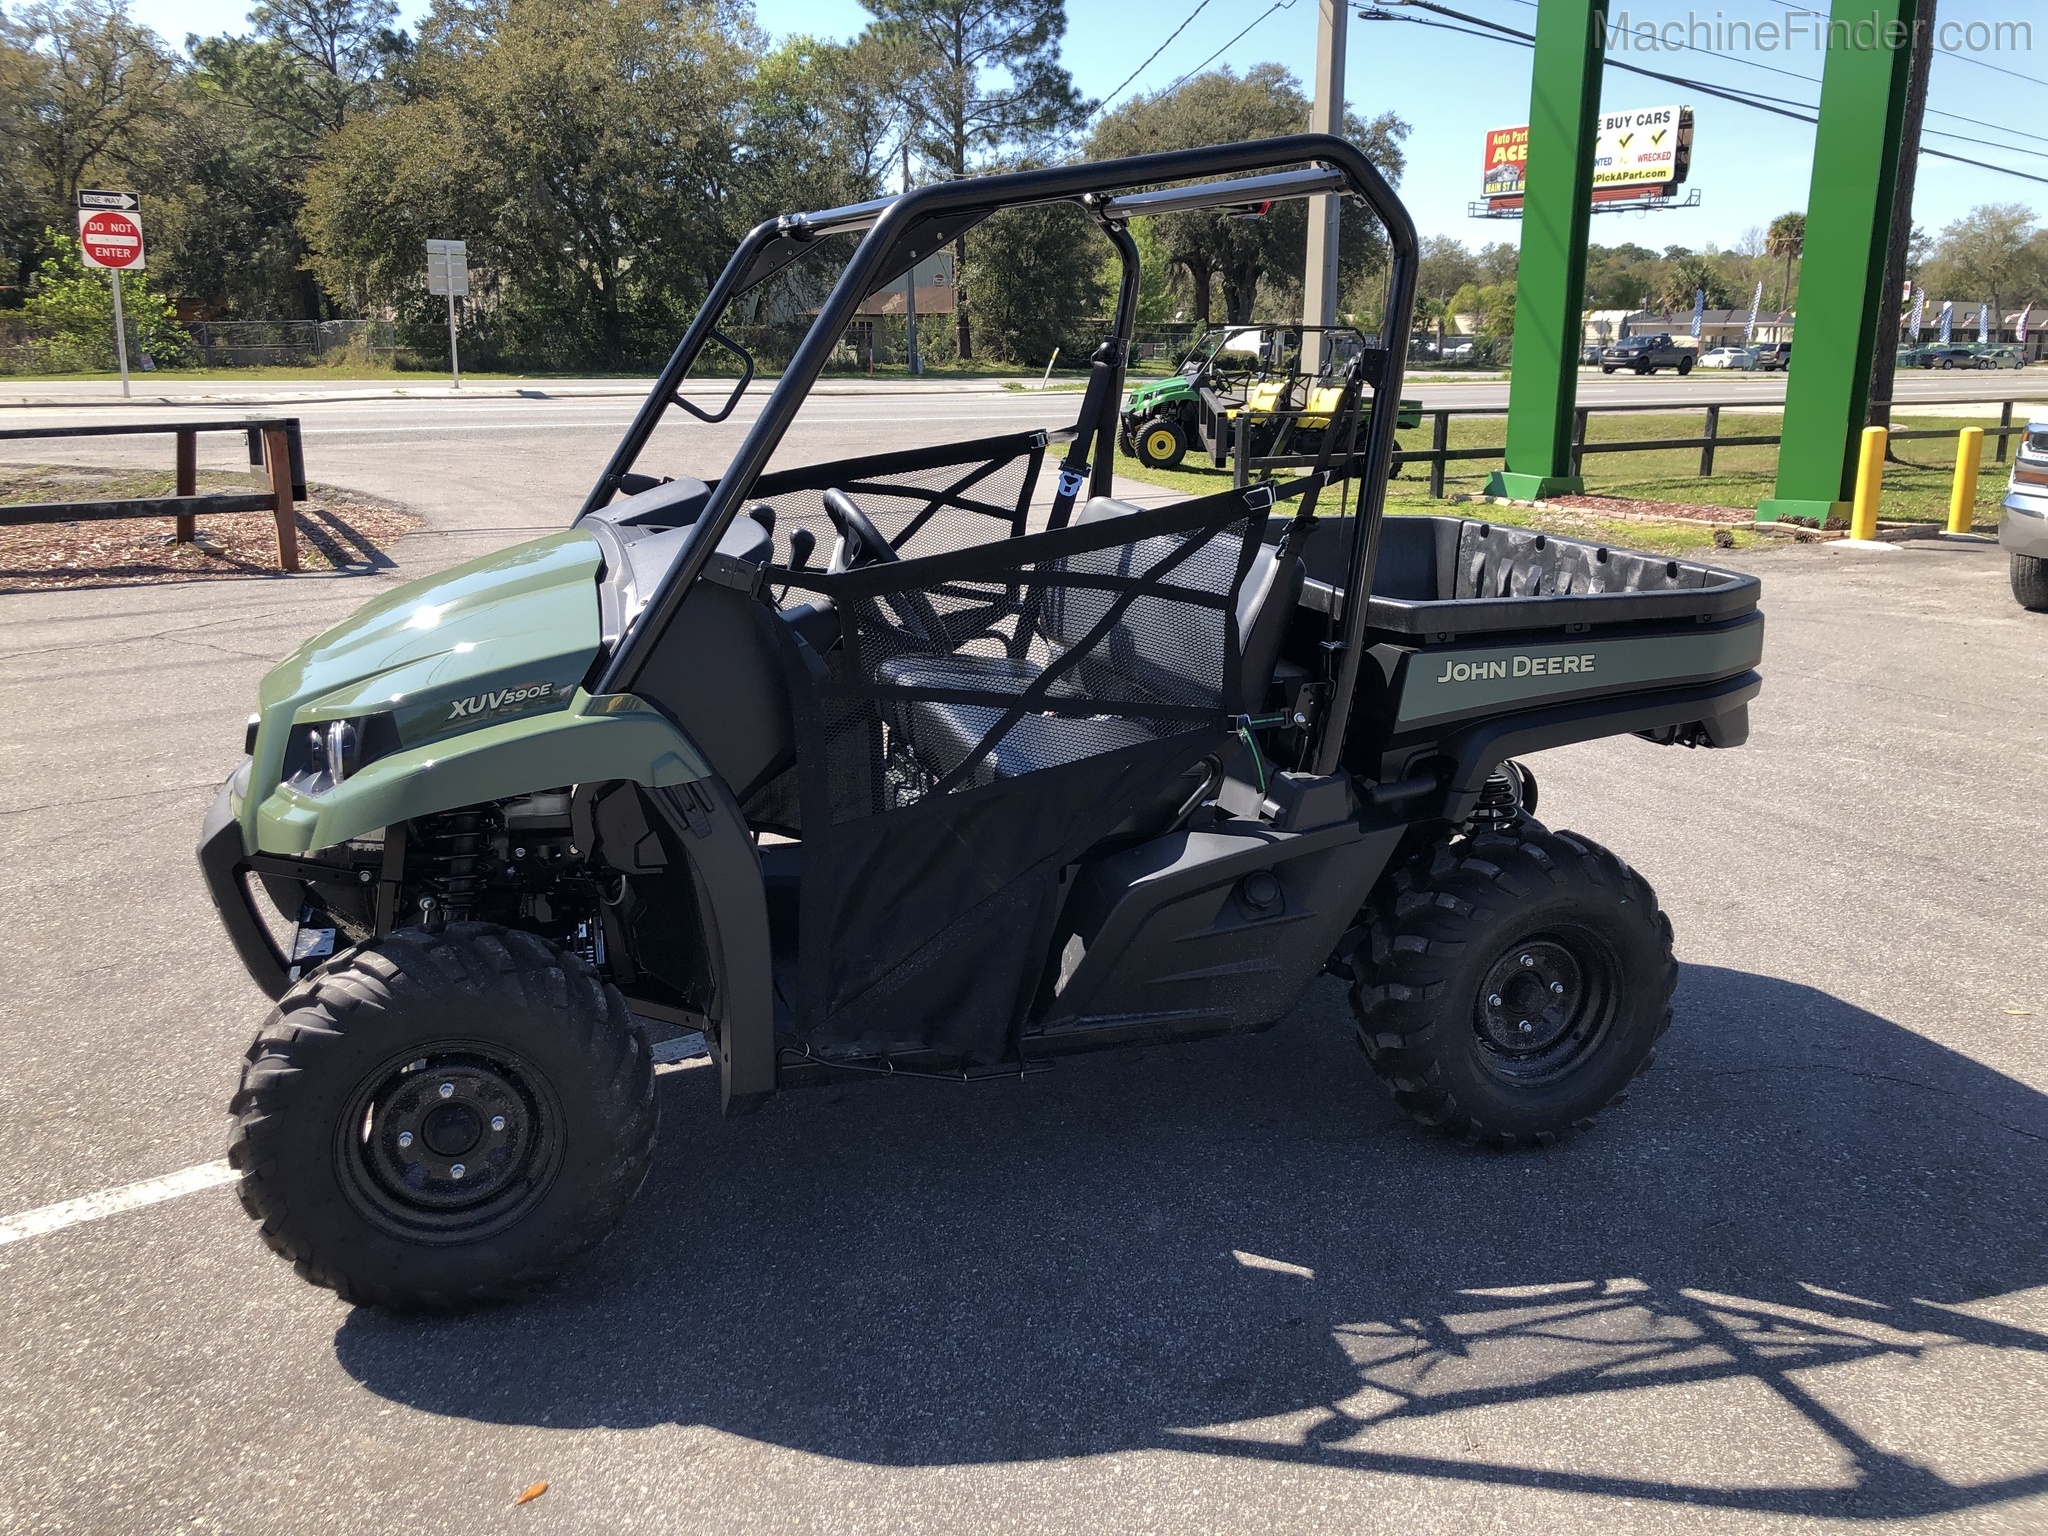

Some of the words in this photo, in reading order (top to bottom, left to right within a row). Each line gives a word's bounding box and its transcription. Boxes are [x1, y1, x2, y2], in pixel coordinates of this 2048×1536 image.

[1606, 115, 1632, 130] BUY
[1636, 110, 1671, 126] CARS
[1493, 133, 1510, 145] Auto
[1492, 144, 1528, 163] ACE
[1637, 151, 1671, 163] WRECKED
[1486, 182, 1501, 193] MAIN
[1502, 181, 1511, 192] ST
[89, 222, 104, 231] DO
[110, 223, 132, 233] NOT
[95, 247, 131, 258] ENTER
[1437, 660, 1507, 683] JOHN
[1512, 654, 1596, 678] DEERE
[447, 682, 553, 719] XUV590E
